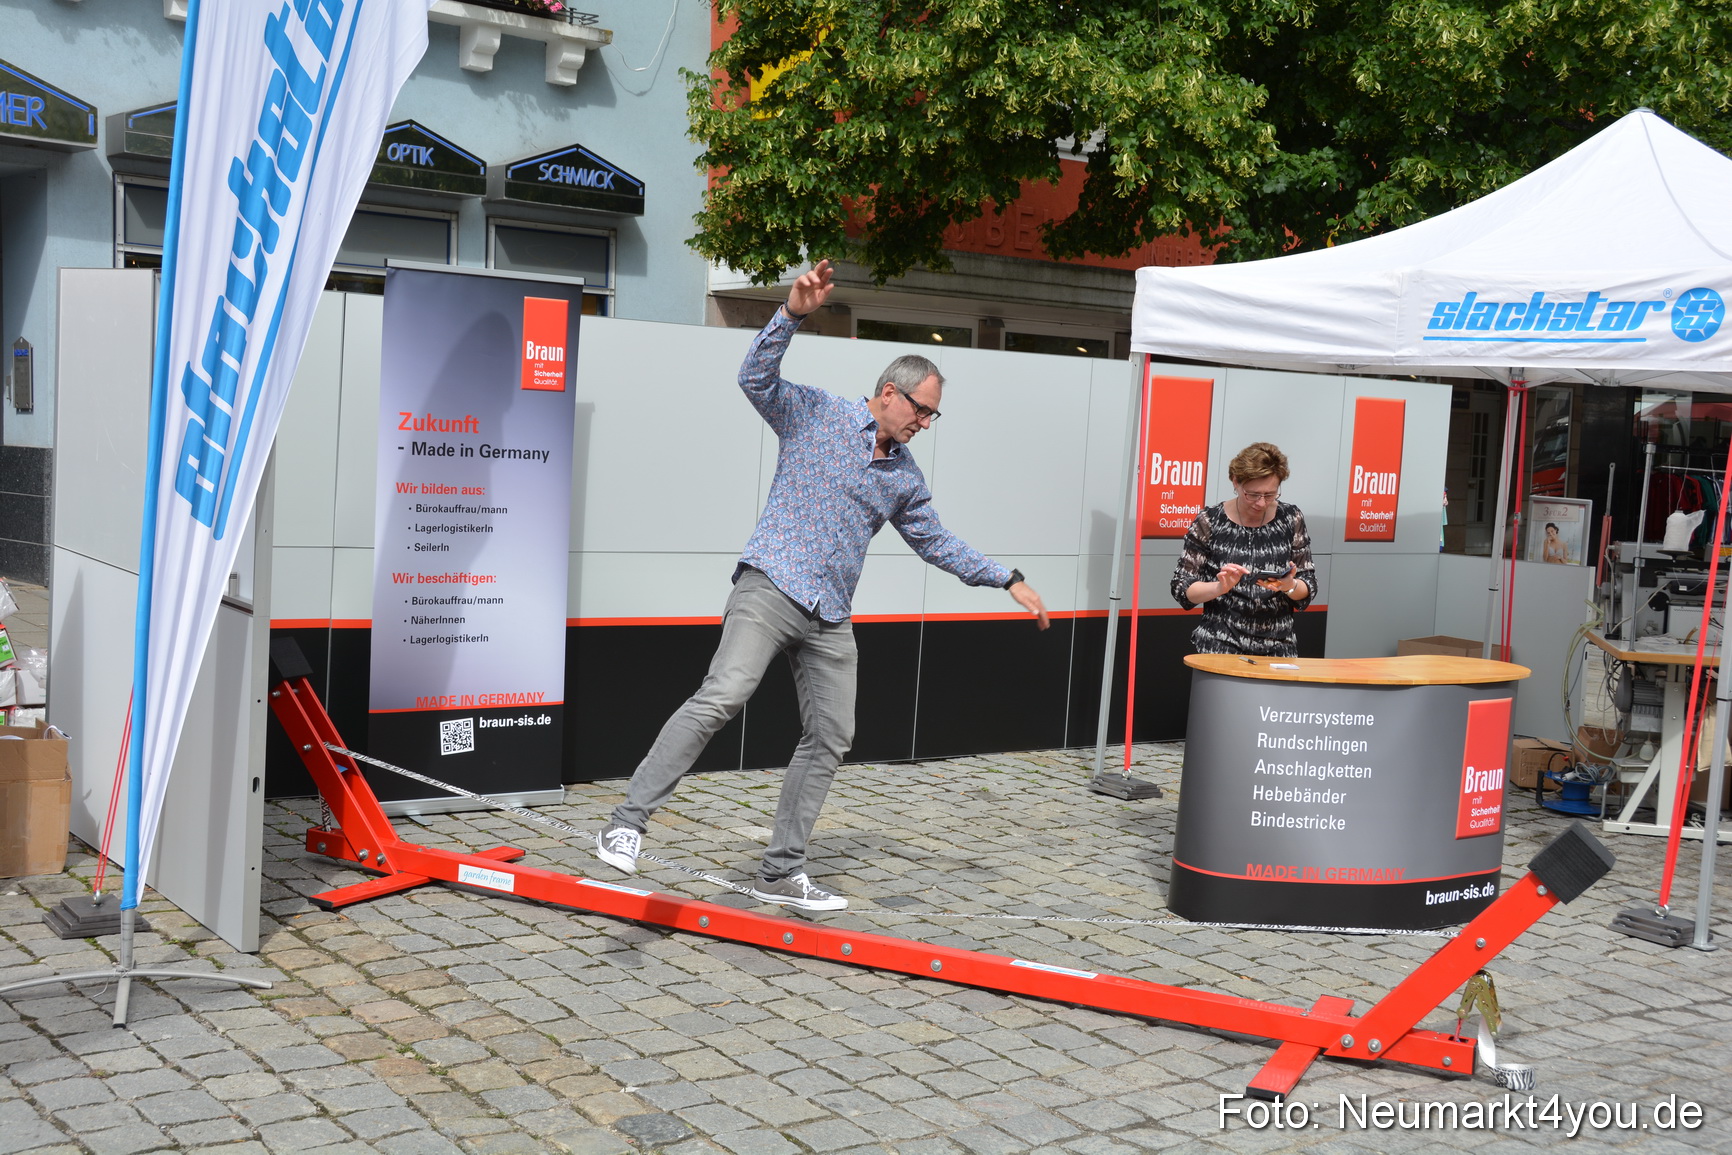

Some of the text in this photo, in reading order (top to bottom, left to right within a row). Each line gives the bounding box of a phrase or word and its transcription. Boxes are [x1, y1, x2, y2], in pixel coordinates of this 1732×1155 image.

[387, 142, 434, 167] OPTIK
[538, 163, 615, 190] SCHMUCK
[1427, 291, 1666, 332] slackstar
[526, 340, 564, 362] Braun
[534, 370, 563, 378] Sicherheit
[398, 411, 480, 434] Zukunft
[411, 441, 456, 457] Made
[460, 442, 474, 457] in
[479, 444, 550, 463] Germany
[1150, 452, 1203, 486] Braun
[1352, 464, 1397, 495] Braun
[396, 482, 486, 496] Wir bilden aus:
[1161, 489, 1174, 500] mit
[415, 503, 508, 514] Bürokauffrau/mann
[1159, 503, 1201, 515] Sicherheit
[1361, 498, 1373, 507] mit
[1360, 510, 1394, 520] Sicherheit
[414, 523, 494, 534] LagerlogistikerIn
[1359, 522, 1388, 532] Qualität.
[414, 543, 450, 552] SeilerIn
[392, 572, 497, 586] Wir beschäftigen:
[411, 595, 504, 606] Bürokauffrau/mann
[410, 615, 466, 625] NäherInnen
[410, 633, 489, 645] LagerlogistikerIn
[415, 691, 545, 708] MADE IN GERMANY
[479, 713, 552, 728] braun-sis.de
[1259, 705, 1375, 727] Verzurrsysteme
[1257, 732, 1369, 755] Rundschlingen
[1253, 758, 1372, 780] Anschlagketten
[1464, 766, 1504, 794] Braun
[1252, 784, 1347, 805] Hebebänder
[1472, 795, 1483, 805] mit
[1471, 804, 1501, 817] Sicherheit
[1250, 810, 1346, 831] Bindestricke
[461, 868, 512, 886] garden frame
[1245, 863, 1406, 882] MADE IN GERMANY
[1425, 882, 1496, 906] braun-sis.de
